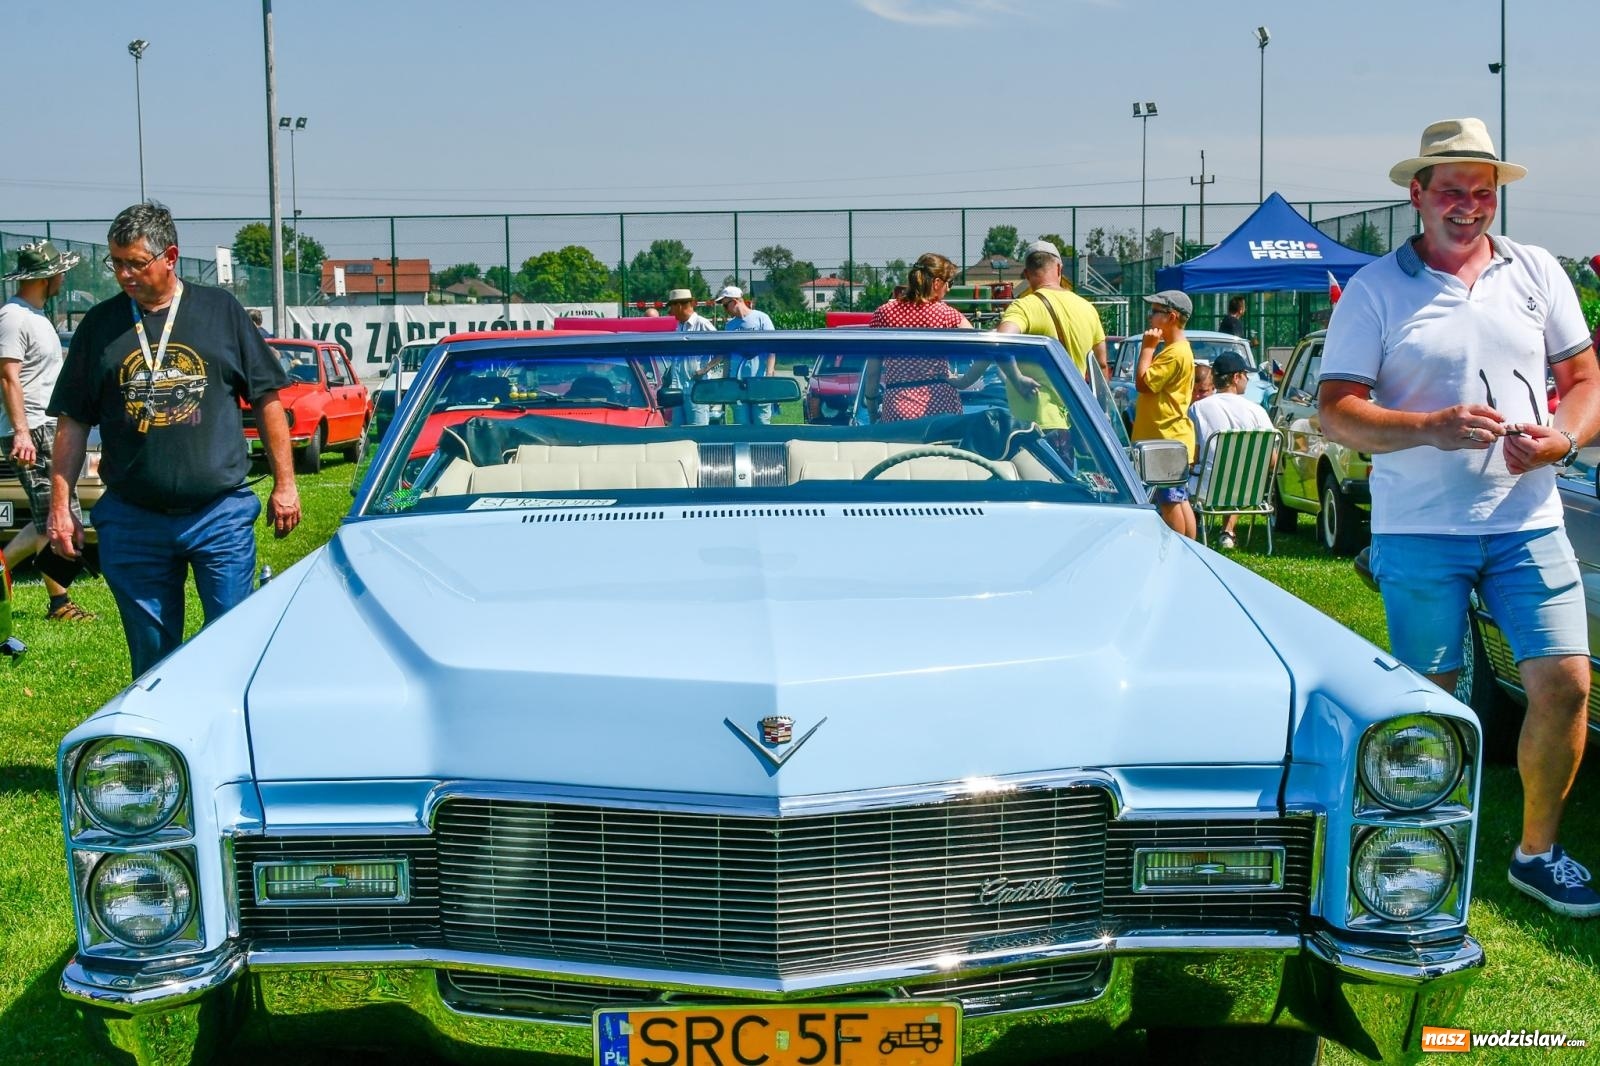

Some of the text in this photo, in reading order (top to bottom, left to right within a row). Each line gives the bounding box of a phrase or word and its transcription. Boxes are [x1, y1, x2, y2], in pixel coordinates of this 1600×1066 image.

[1248, 240, 1306, 251] LECH
[1251, 250, 1323, 259] FREE
[640, 1013, 869, 1066] SRC 5F
[604, 1051, 627, 1065] PL
